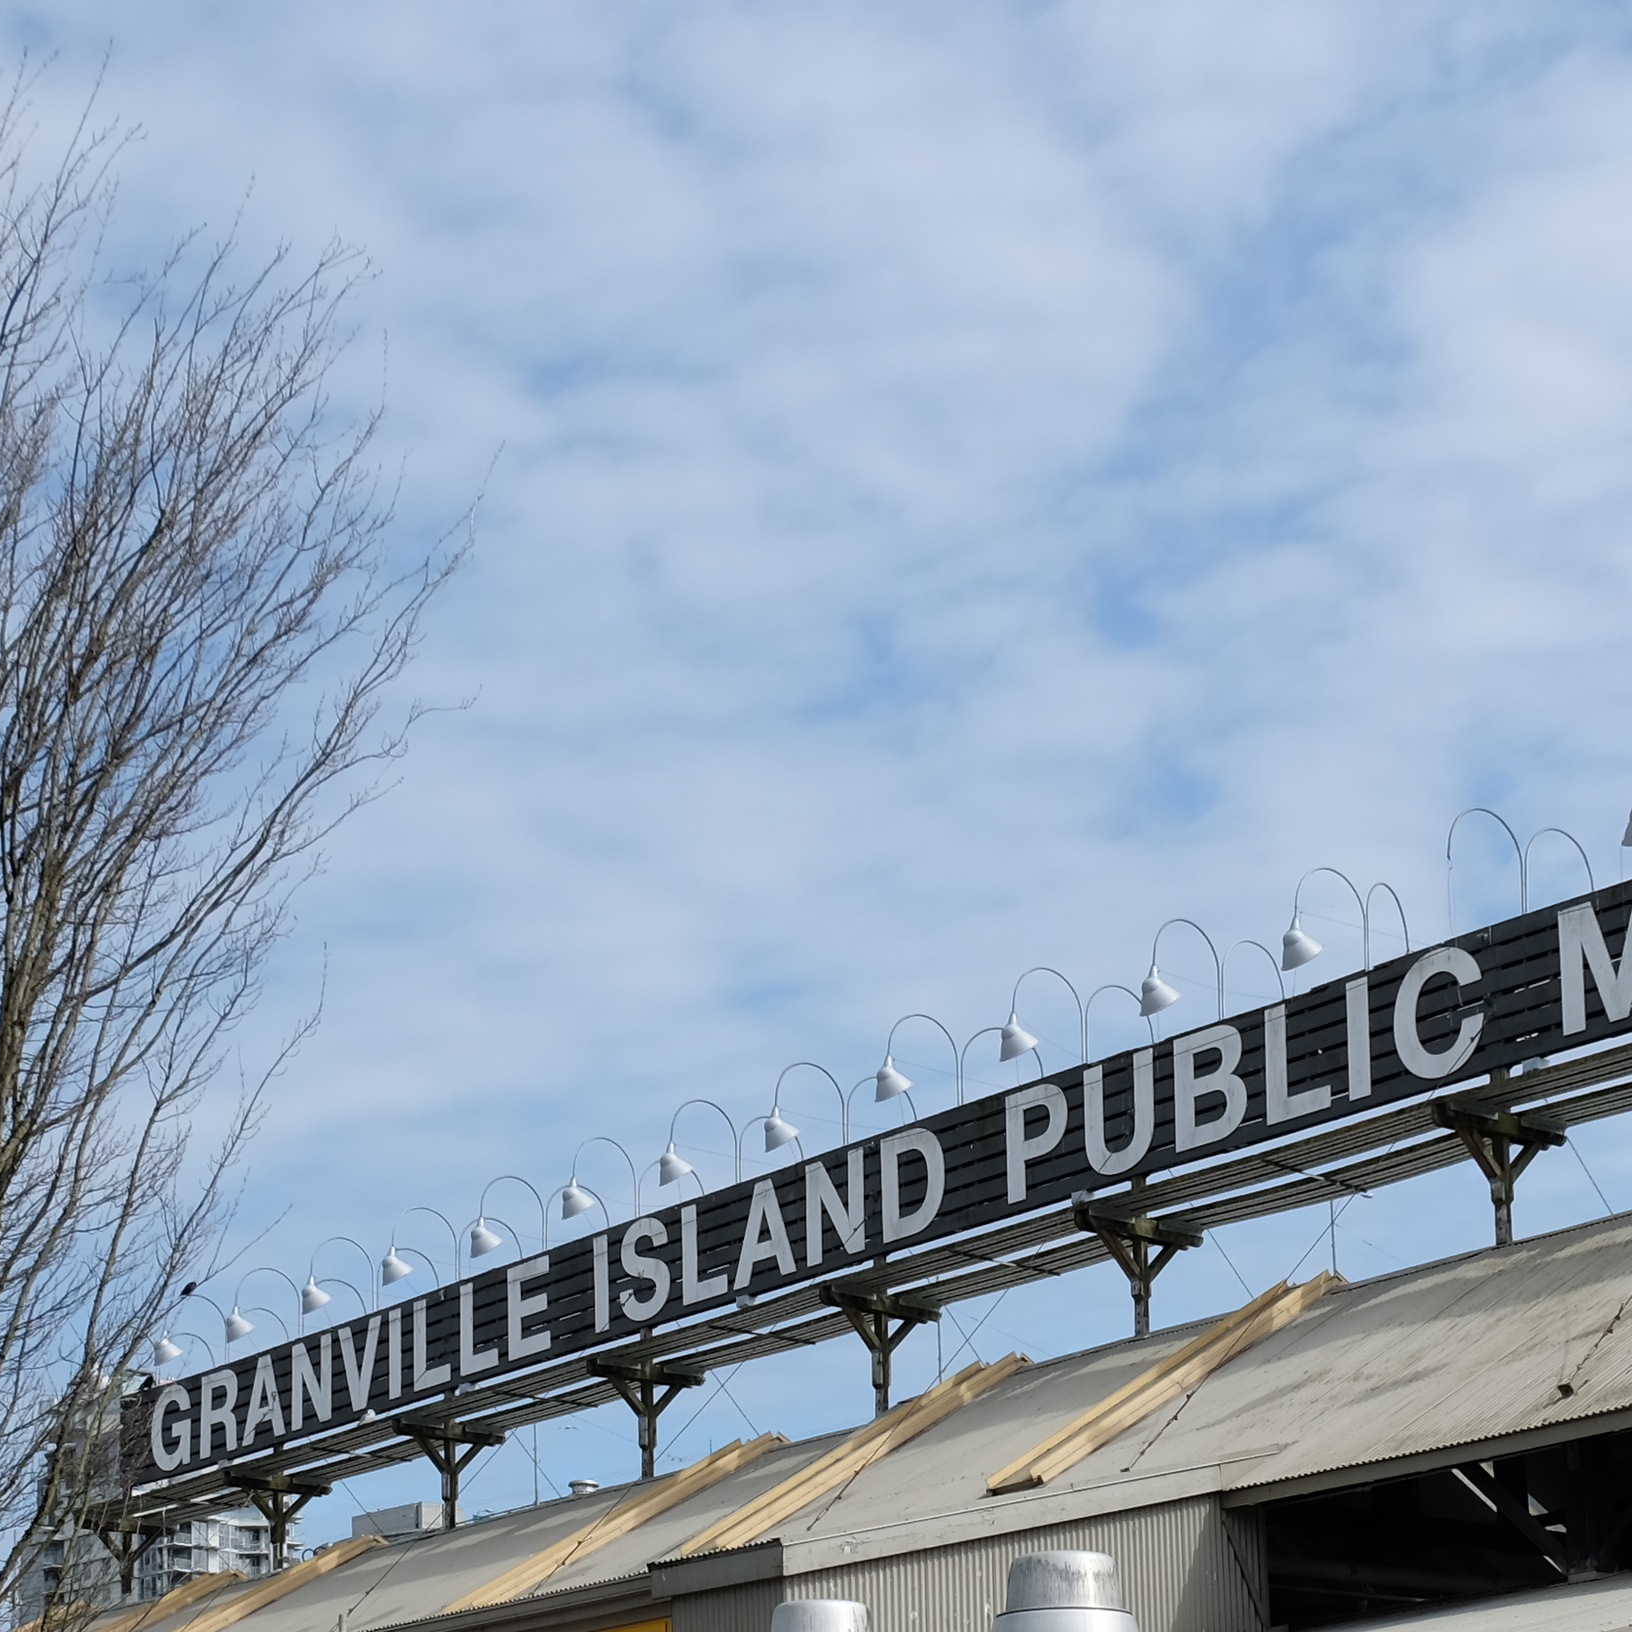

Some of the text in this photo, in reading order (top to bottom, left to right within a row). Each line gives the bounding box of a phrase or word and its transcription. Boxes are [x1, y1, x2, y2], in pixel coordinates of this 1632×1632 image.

[150, 1255, 551, 1471] GRANVILLE
[593, 1127, 945, 1333] ISLAND
[1004, 946, 1485, 1205] PUBLIC
